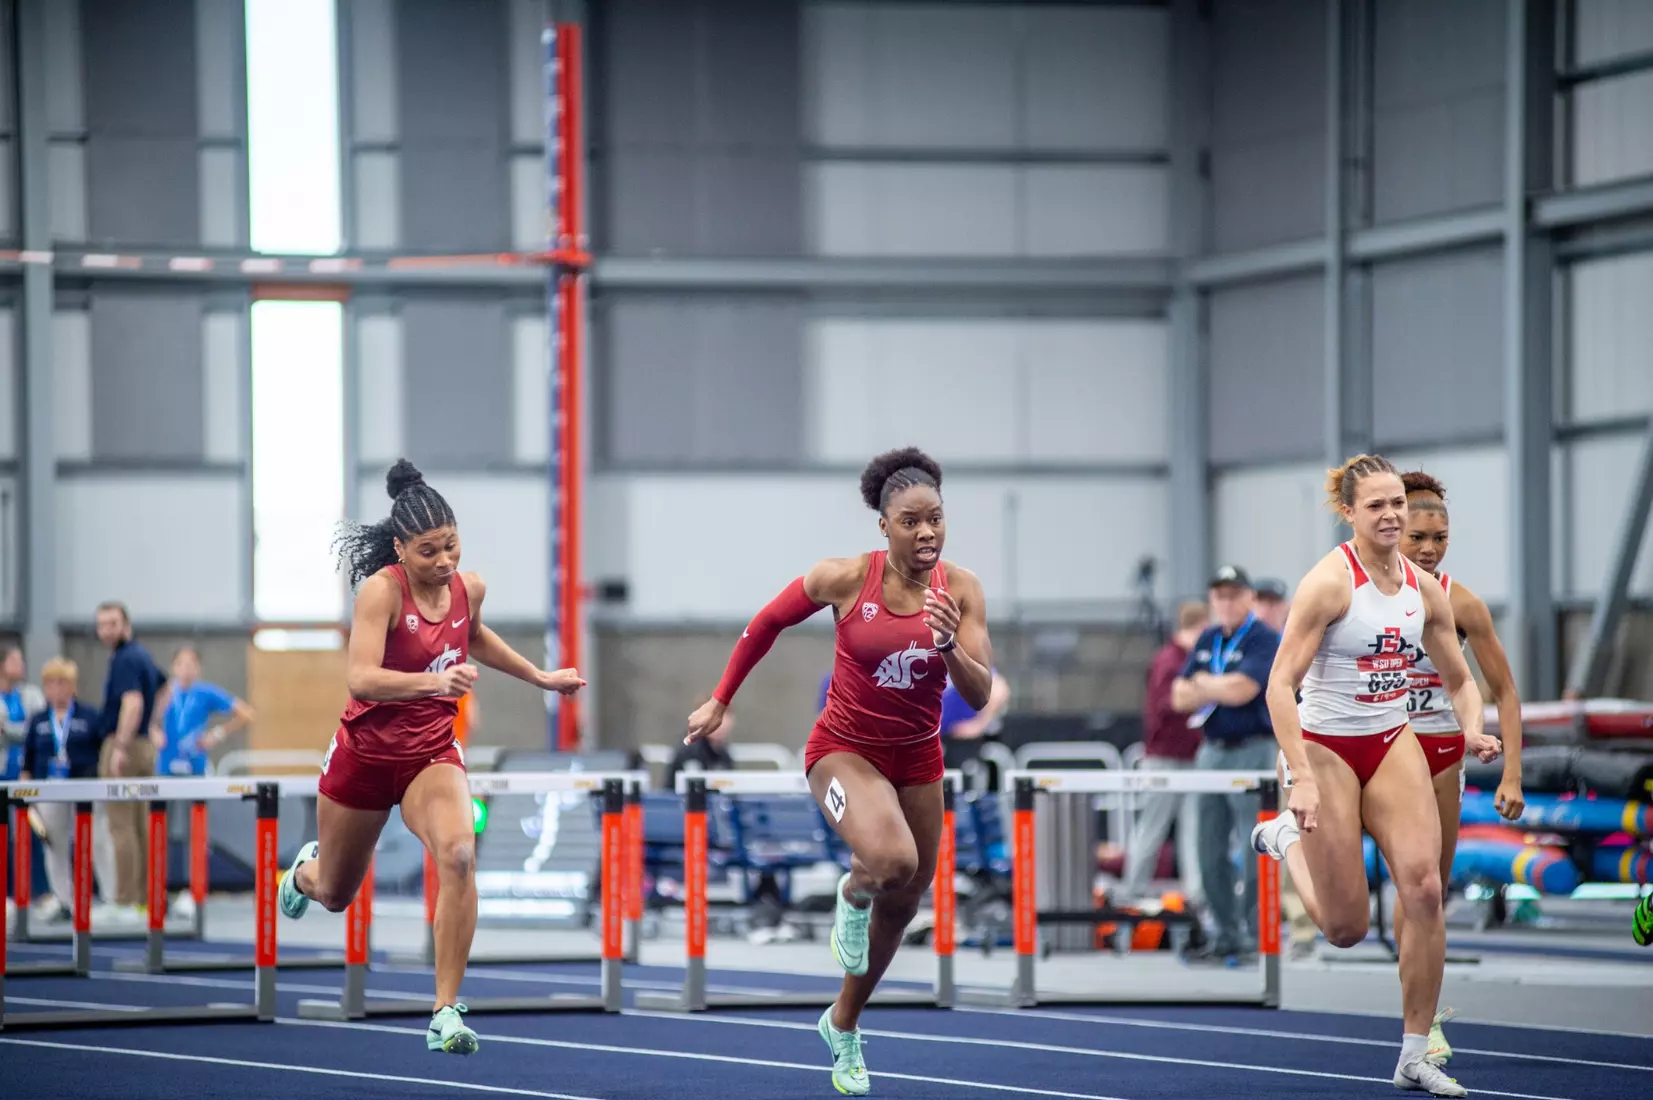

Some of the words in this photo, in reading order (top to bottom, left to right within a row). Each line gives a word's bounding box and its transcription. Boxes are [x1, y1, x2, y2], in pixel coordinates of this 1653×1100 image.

[1372, 659, 1389, 669] WSU
[1367, 672, 1407, 693] 655
[829, 786, 845, 813] 4
